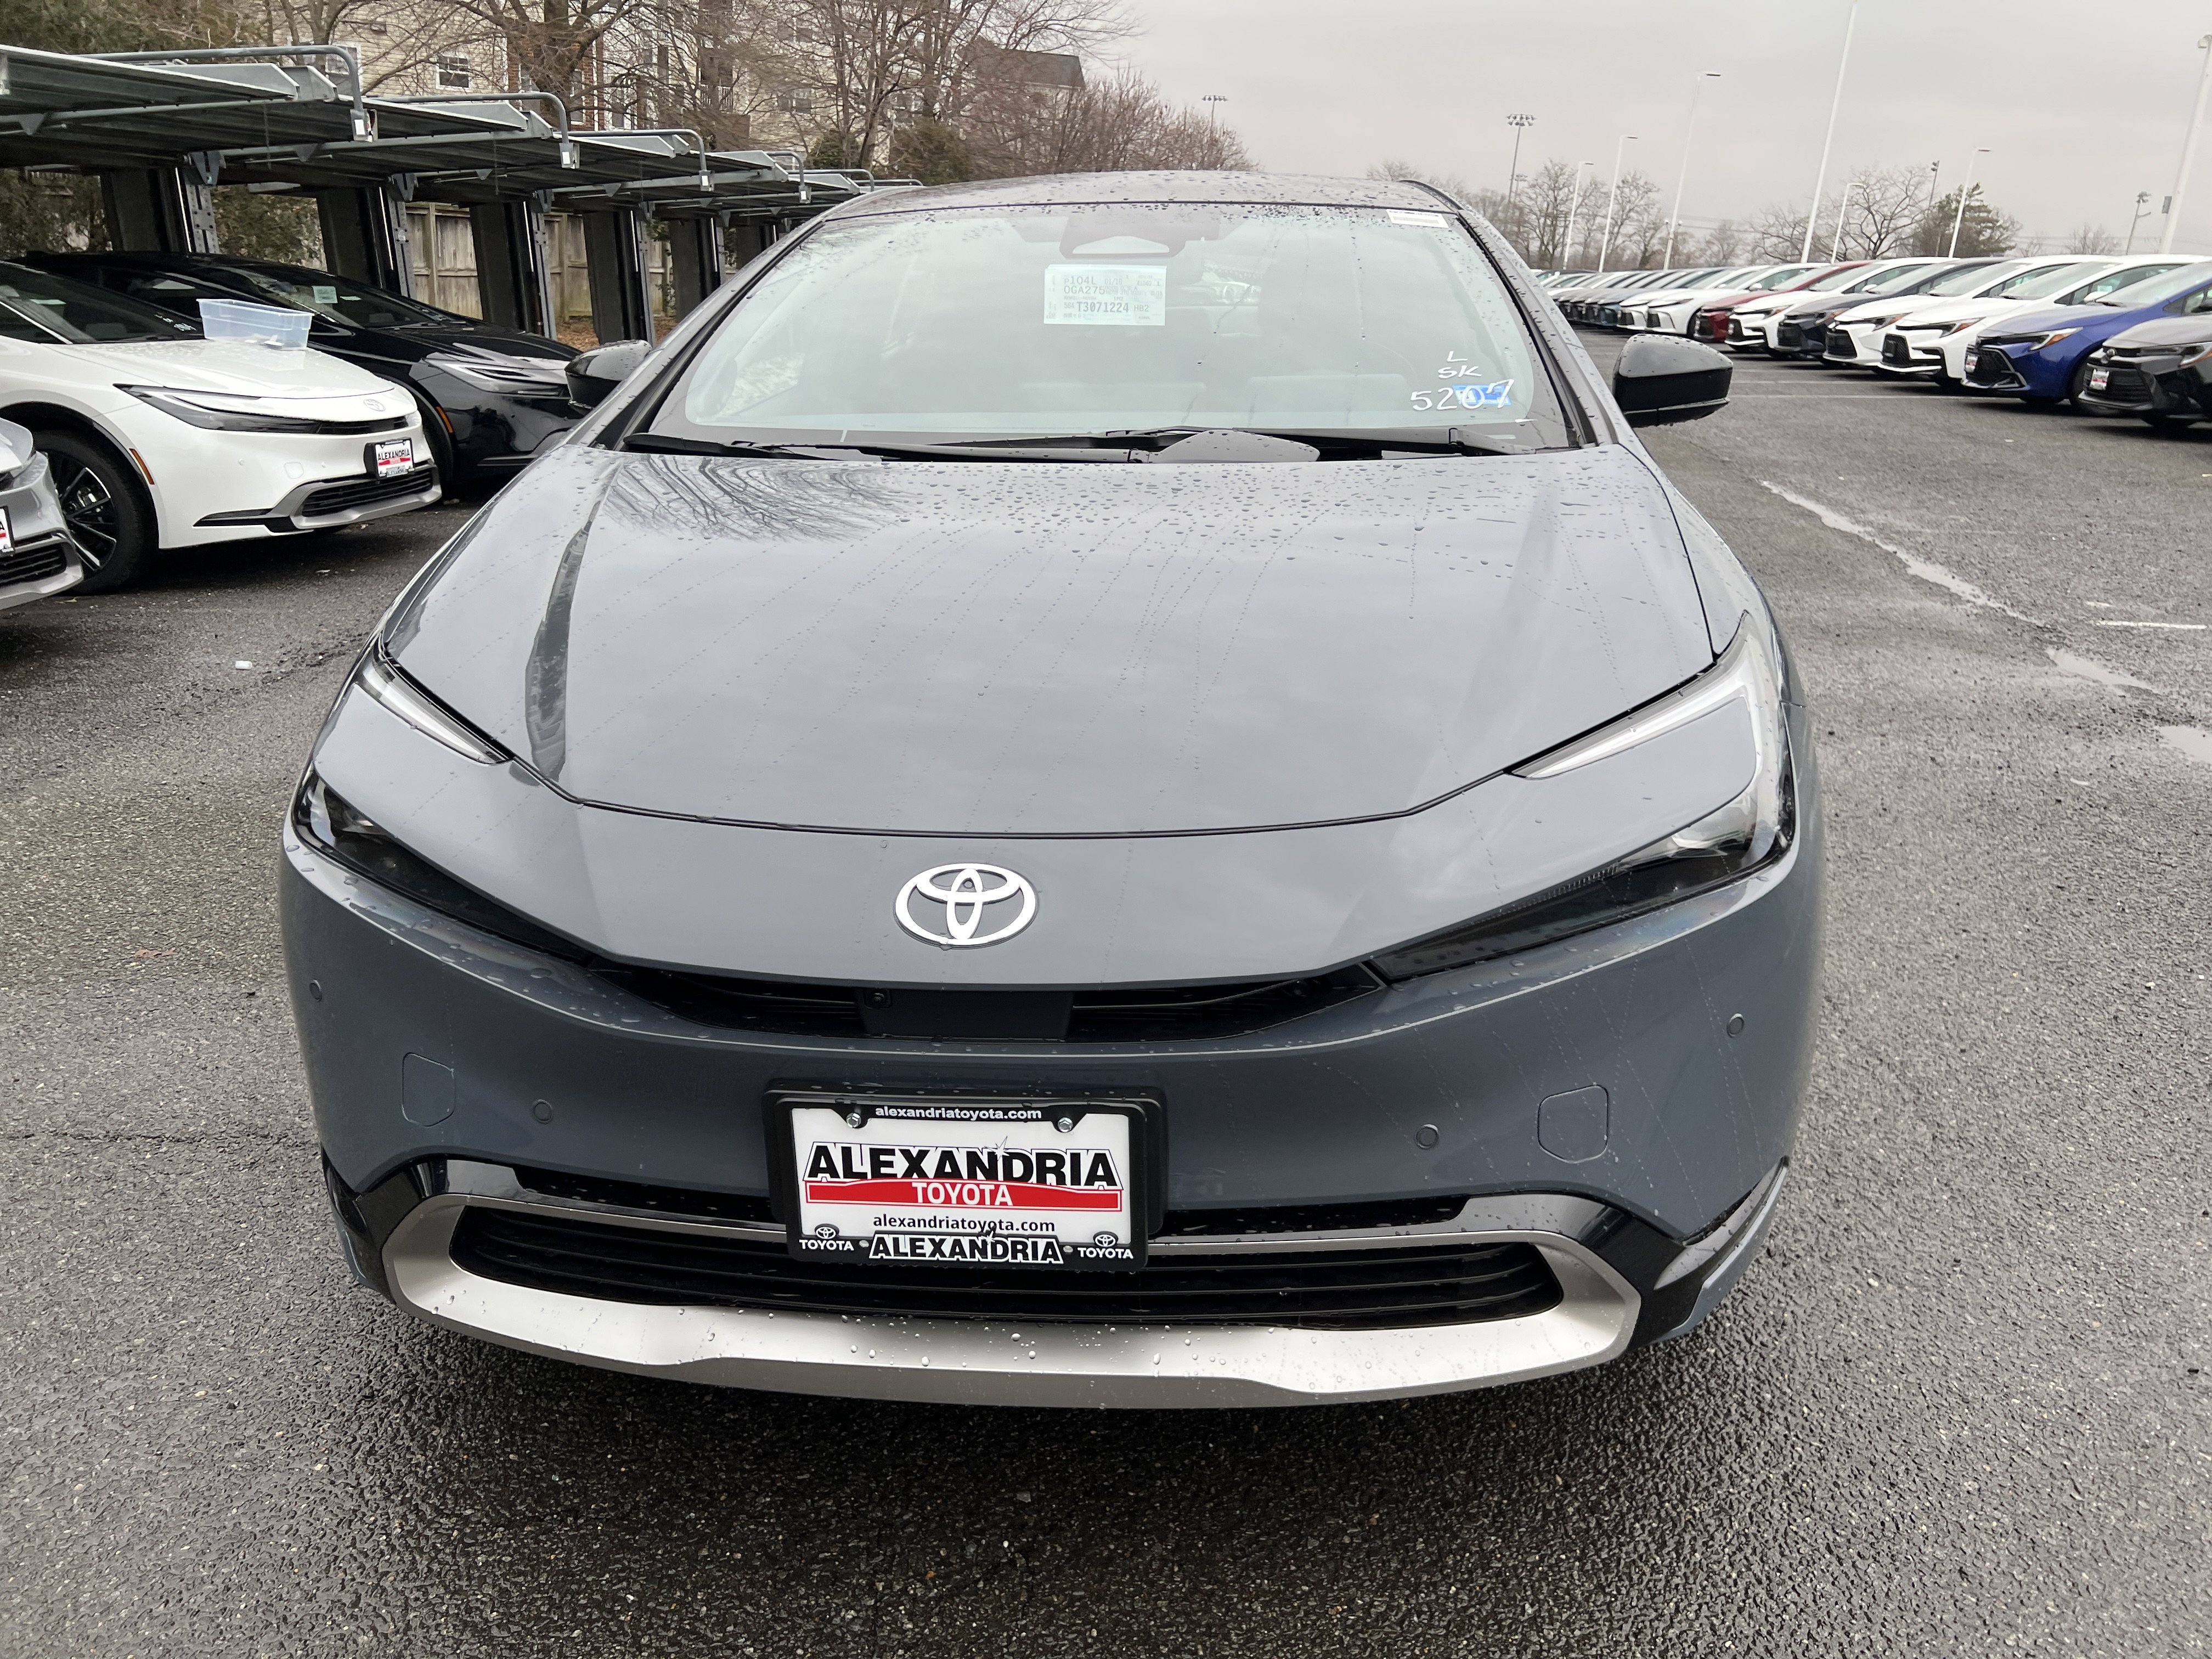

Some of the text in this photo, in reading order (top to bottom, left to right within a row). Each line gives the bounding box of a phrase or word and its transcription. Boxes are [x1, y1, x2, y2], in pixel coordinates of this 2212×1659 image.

[1076, 301, 1128, 313] T3071224
[1447, 351, 1468, 362] L
[1410, 379, 1515, 410] 5207
[377, 449, 410, 461] ALEXANDRIA
[875, 1106, 1042, 1121] alexandriatoyota.com
[805, 1143, 1122, 1188] ALEXANDRIA
[912, 1182, 1013, 1206] TOYOTA
[873, 1214, 1056, 1232] alexandriatoyota.com
[799, 1239, 854, 1251] TOYOTA
[870, 1233, 1063, 1263] ALEXANDRIA
[1077, 1247, 1133, 1259] TOYOTA
